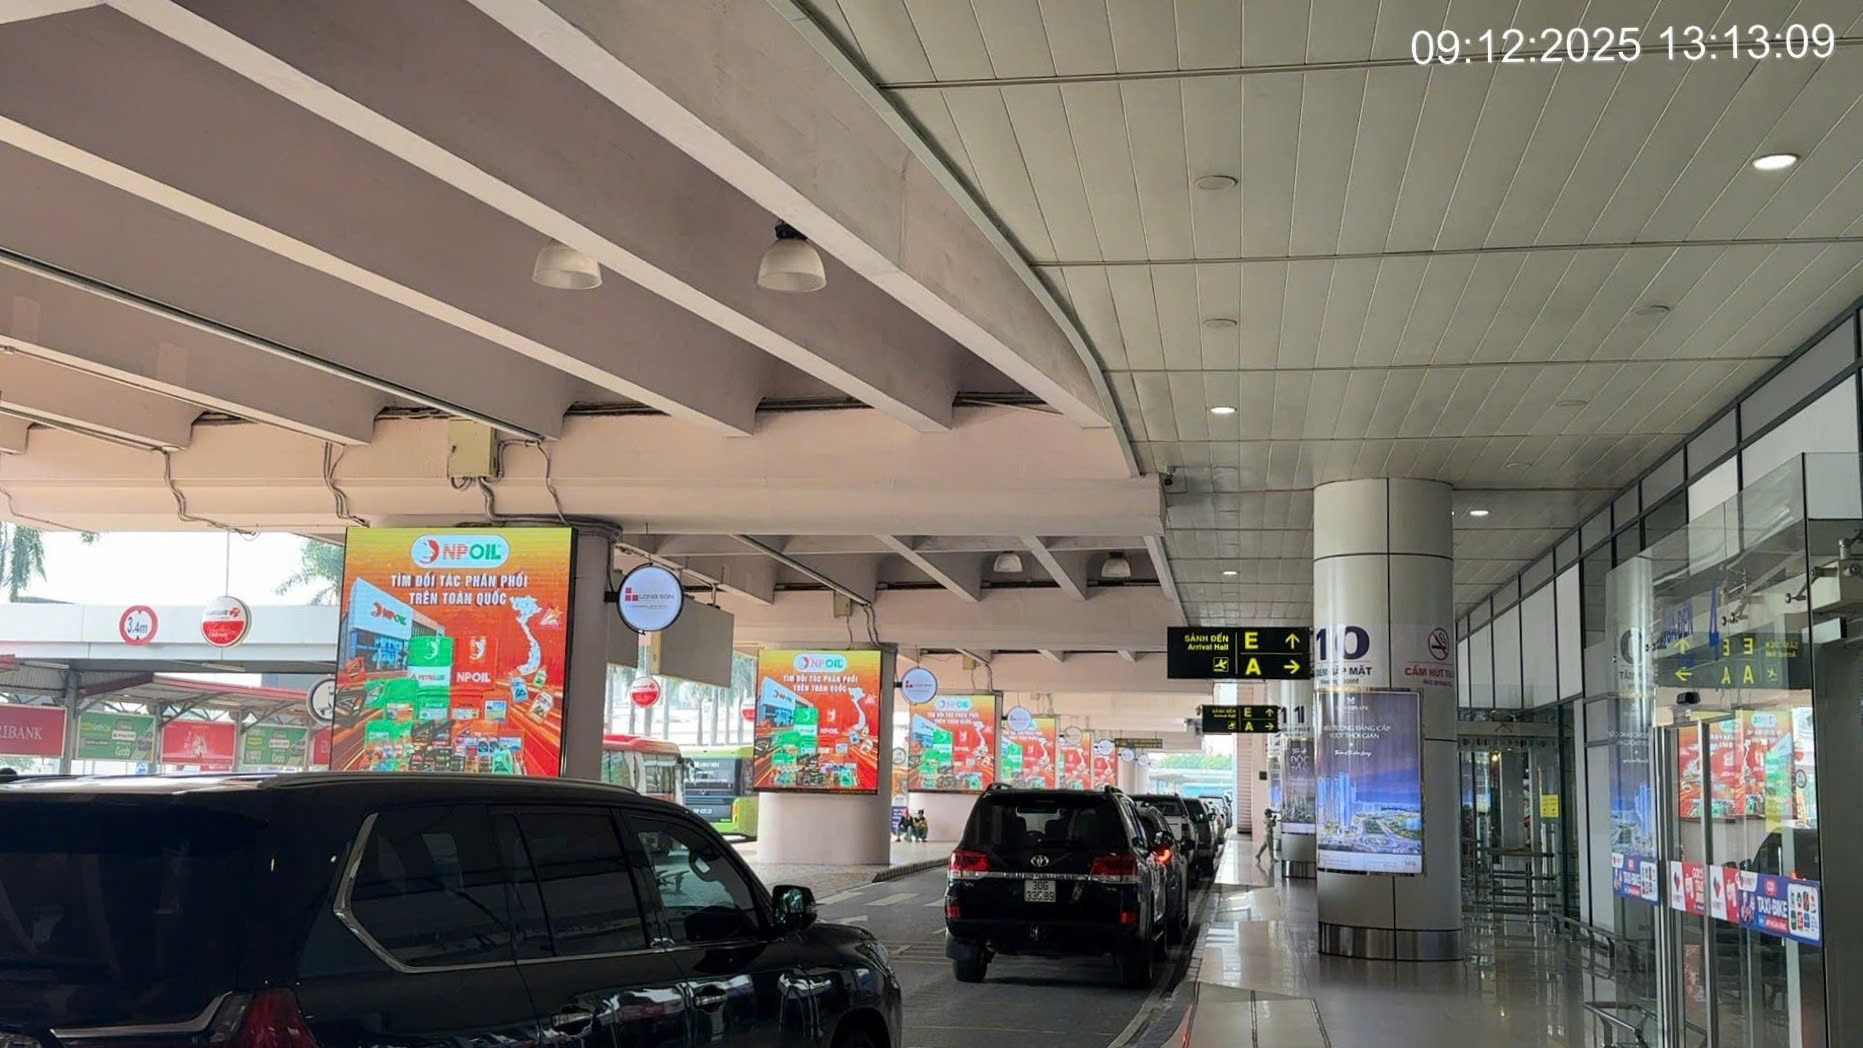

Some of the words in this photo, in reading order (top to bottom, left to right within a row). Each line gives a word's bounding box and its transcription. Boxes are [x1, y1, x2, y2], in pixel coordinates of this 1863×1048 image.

[442, 543, 502, 561] NPOIL
[391, 572, 412, 588] TÌM
[415, 571, 435, 588] ĐỐI
[440, 571, 461, 588] TÁC
[465, 572, 498, 588] PHÂN
[501, 571, 528, 588] PHỐI
[409, 590, 438, 605] TRÊN
[442, 590, 473, 605] TOÀN
[476, 589, 507, 606] QUỐC
[127, 616, 149, 634] 3.4m
[1184, 632, 1209, 643] SẢNH
[1210, 632, 1229, 643] ĐẾN
[1244, 631, 1259, 650] E
[1315, 625, 1370, 661] 10
[1187, 643, 1213, 651] Arrival
[1213, 643, 1229, 651] Hall
[1245, 657, 1262, 676] A
[1349, 665, 1373, 679] MẶT
[456, 672, 492, 683] NPOIL
[1244, 707, 1253, 718] E
[0, 724, 43, 741] IBANK
[1244, 721, 1254, 732] A
[1756, 895, 1788, 919] TAXI-BIKE
